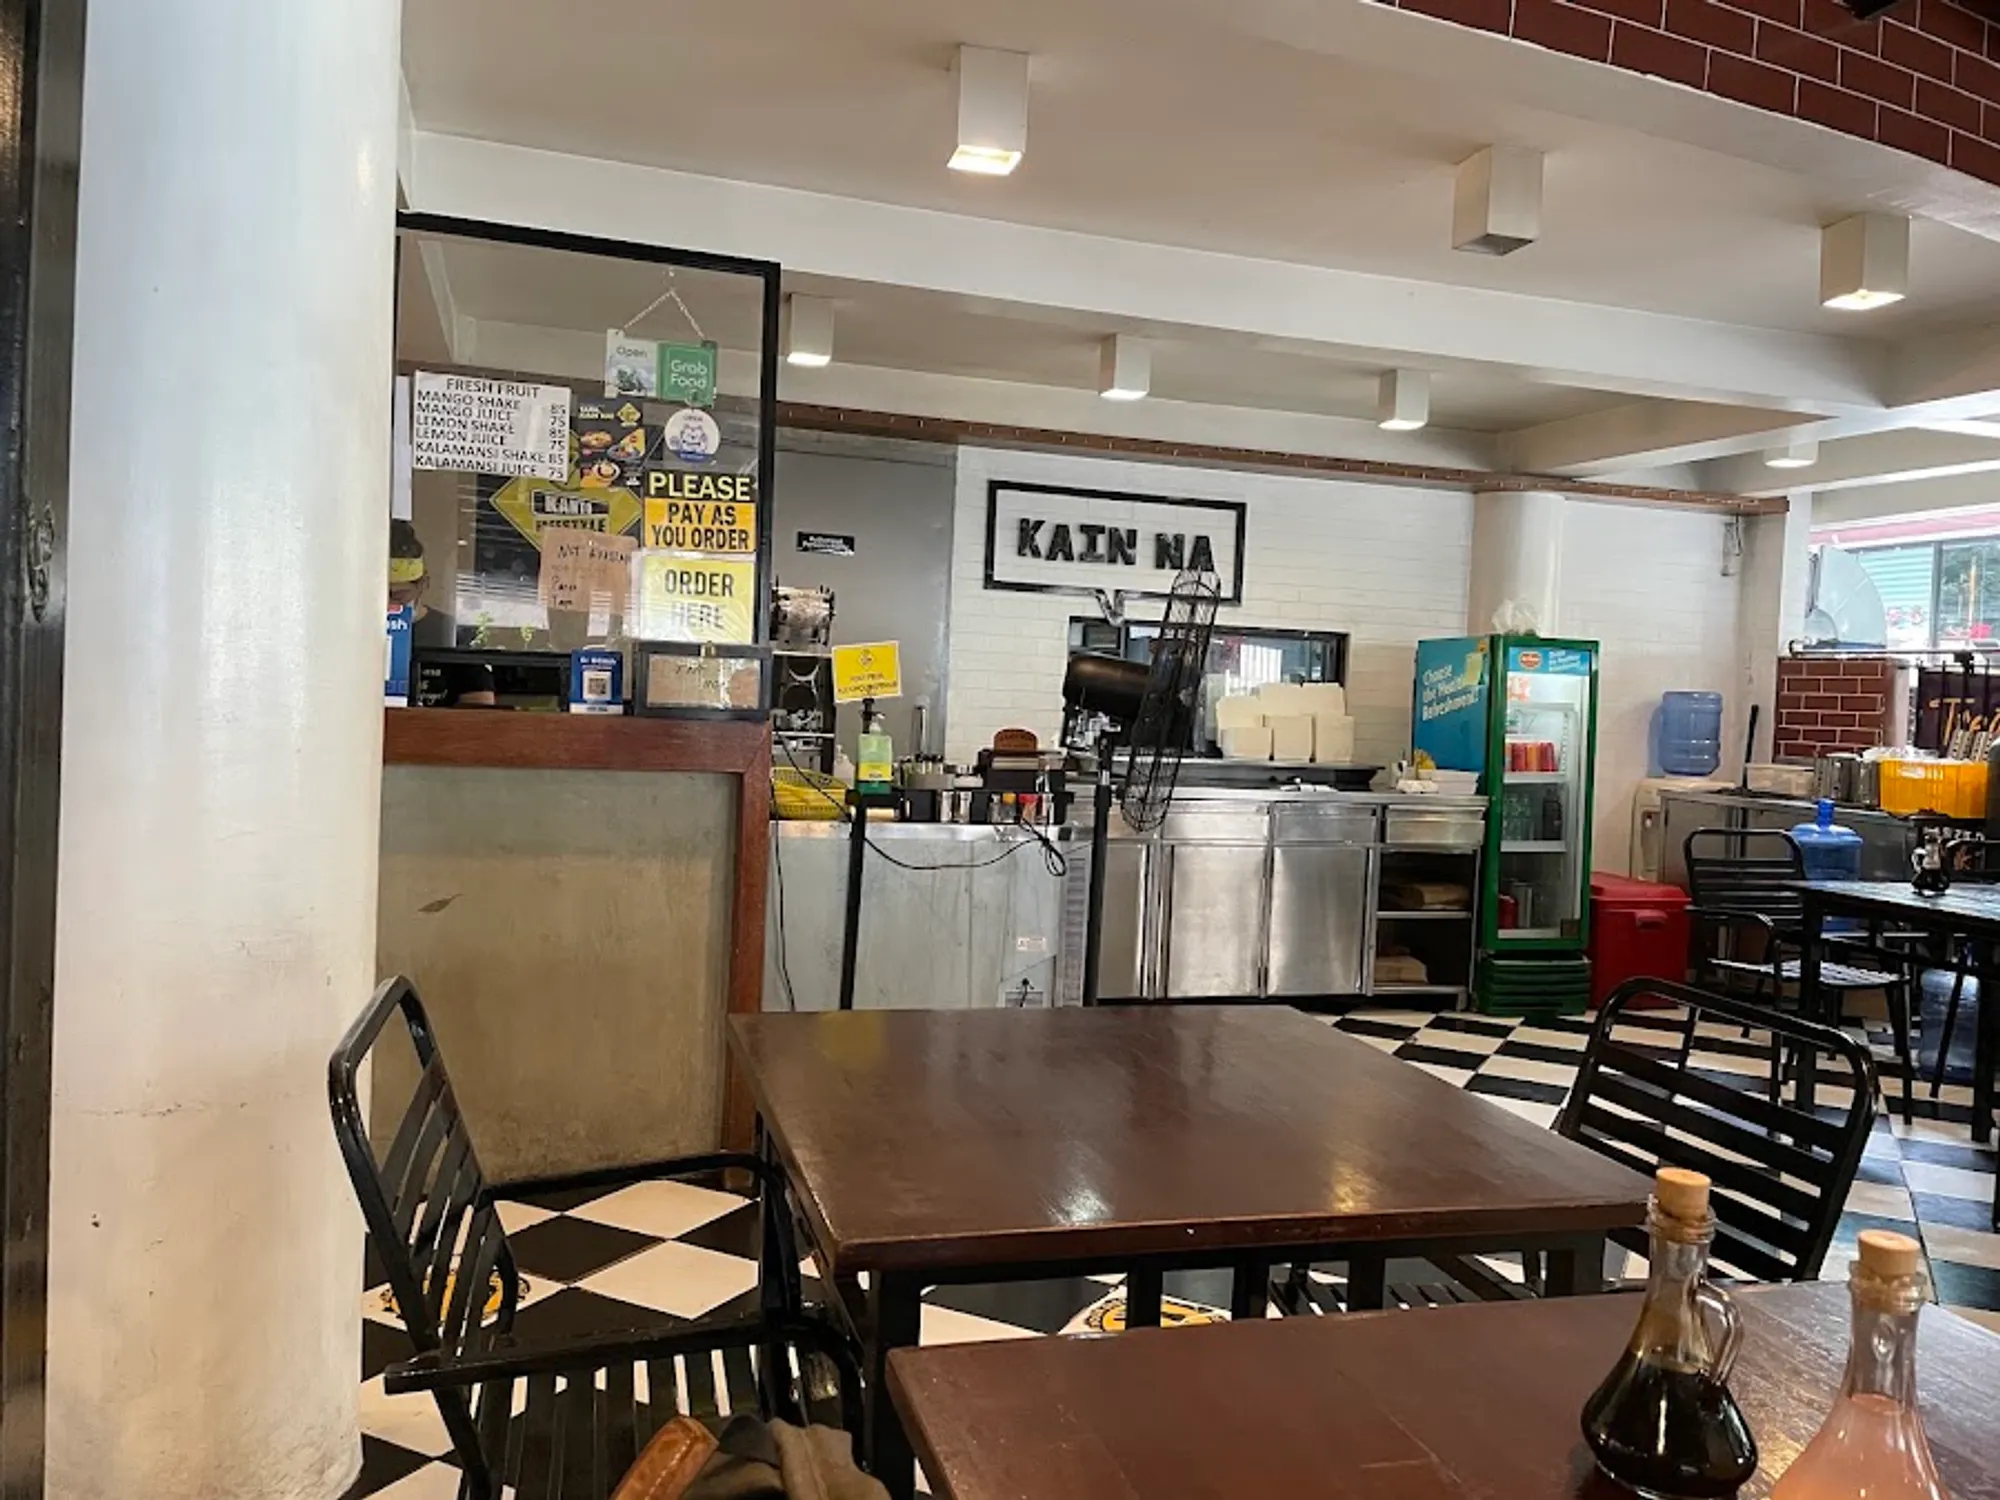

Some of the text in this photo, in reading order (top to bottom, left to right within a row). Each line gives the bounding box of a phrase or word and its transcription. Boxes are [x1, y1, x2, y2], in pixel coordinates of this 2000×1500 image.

[671, 360, 707, 374] Grab
[446, 378, 541, 397] FRESH FRUIT
[671, 374, 707, 388] Food
[417, 390, 474, 405] MANGO
[478, 396, 521, 410] SHAKE
[416, 402, 566, 427] MANGO JUICE 75
[416, 414, 566, 439] LEMON SHAKE 85
[416, 428, 565, 450] LEMON JUICE 75
[416, 442, 498, 459] KALAMANSI
[502, 449, 546, 464] SHAKE
[415, 455, 564, 478] KALAMANSI JUICE 75
[649, 471, 751, 501] PLEASE
[668, 502, 737, 526] PAY AS
[652, 525, 750, 550] YOU ORDER
[1017, 518, 1215, 572] KAIN NA
[664, 569, 735, 597] ORDER
[671, 602, 727, 630] HERE
